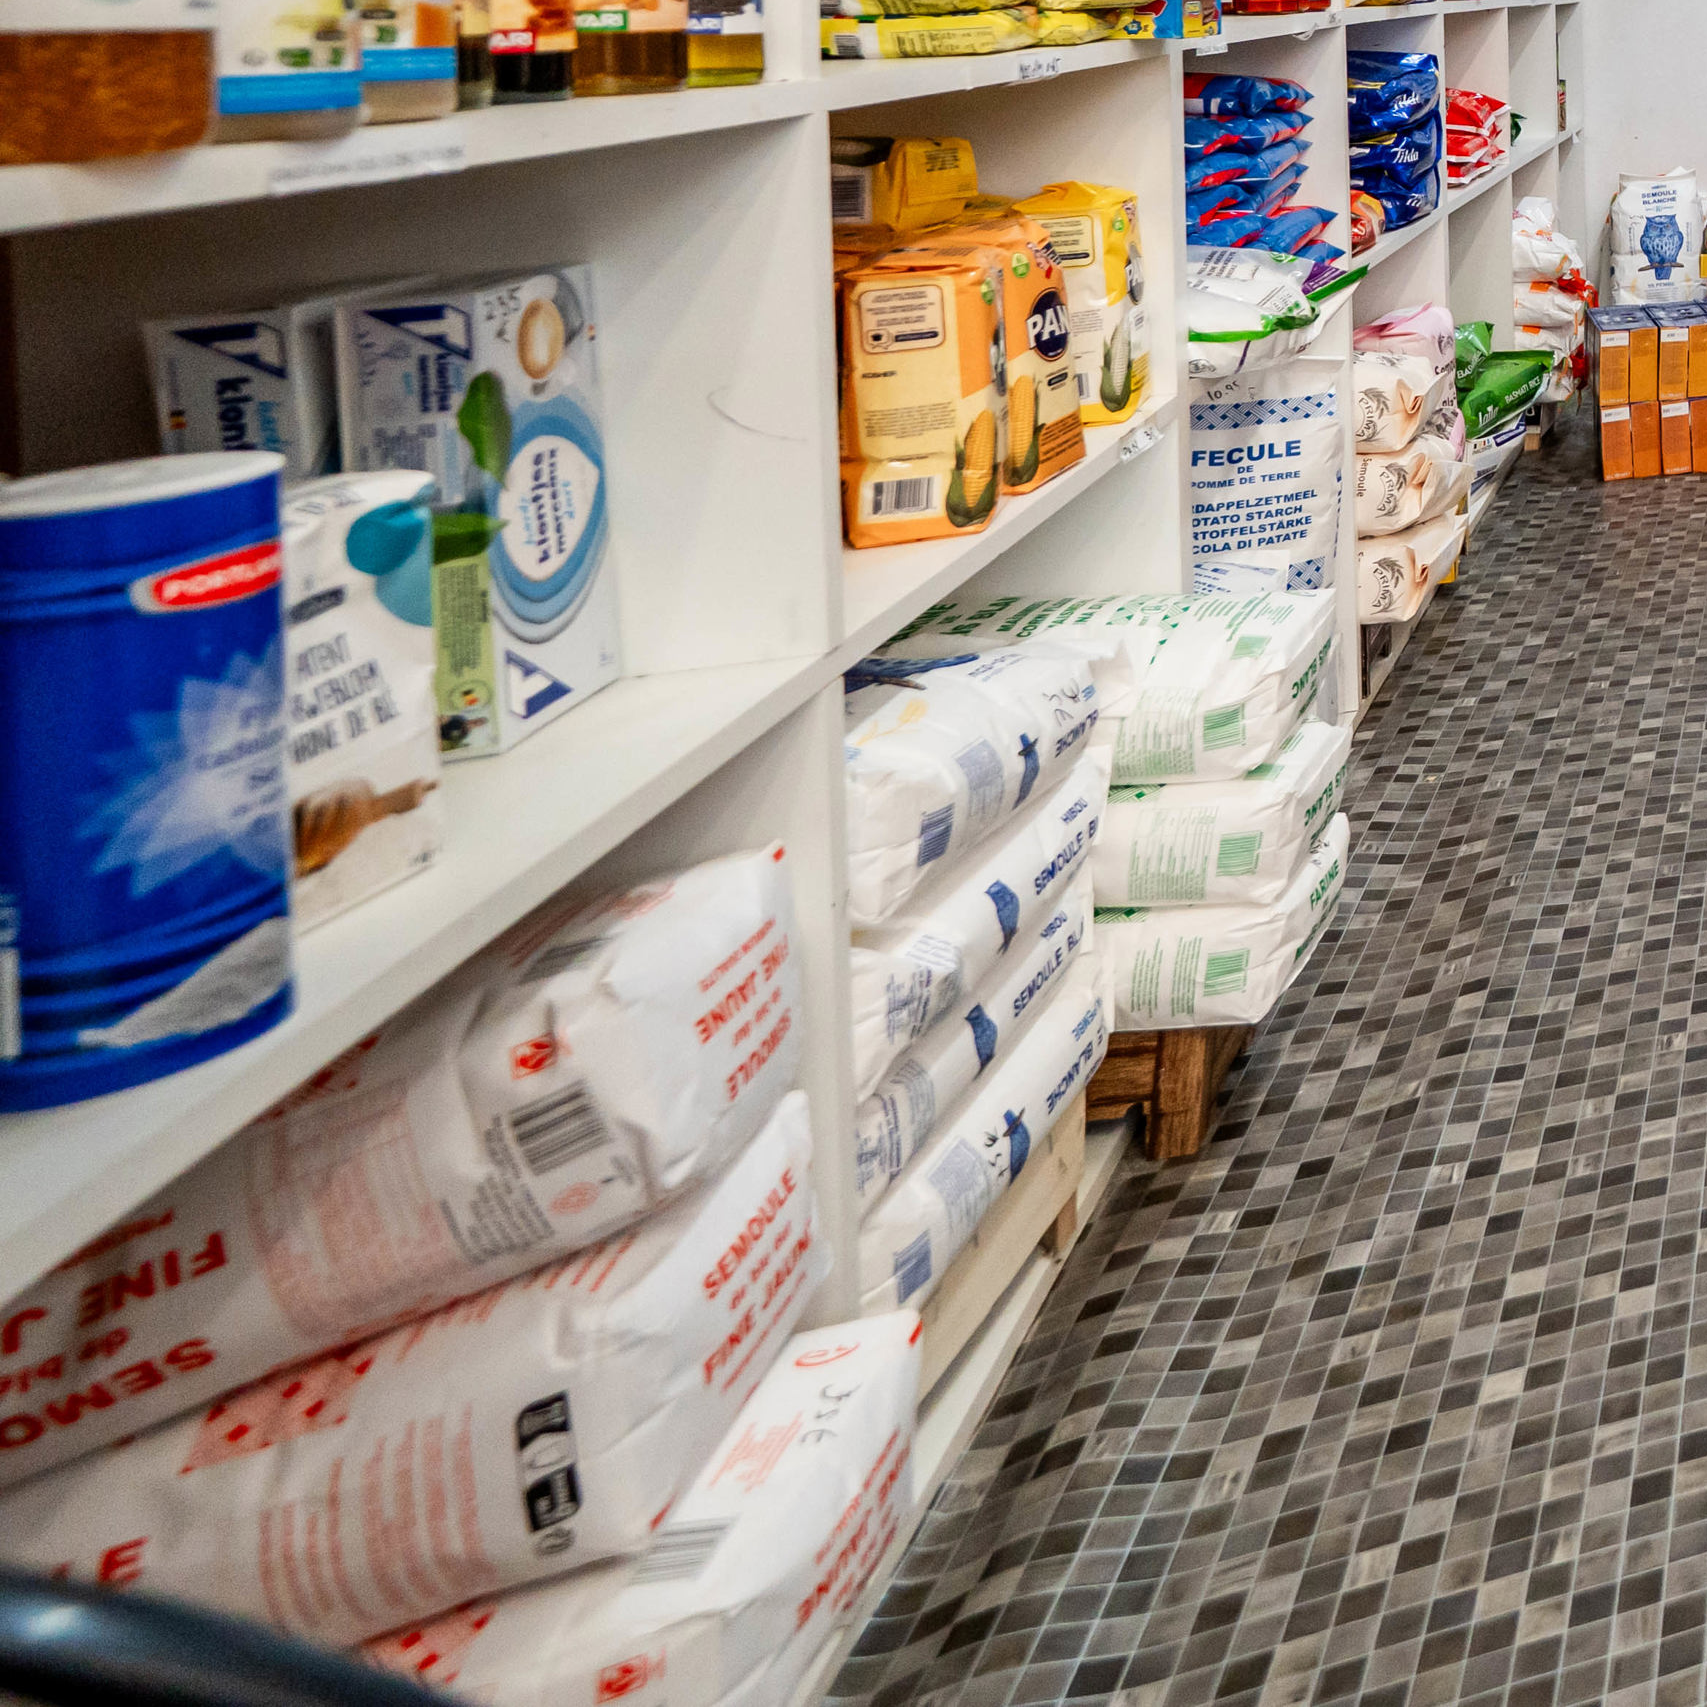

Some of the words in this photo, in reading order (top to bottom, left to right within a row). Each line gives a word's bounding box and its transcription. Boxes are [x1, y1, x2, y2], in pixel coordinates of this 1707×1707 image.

[1393, 146, 1419, 164] Tilda
[1641, 189, 1677, 198] SEMOULE
[1643, 196, 1677, 204] BLANCHE
[1026, 304, 1069, 350] PAN
[1504, 383, 1530, 404] BASMATI
[1355, 397, 1375, 440] PRIMA
[1191, 440, 1302, 467] FECULE
[1237, 465, 1254, 474] DE
[1240, 475, 1256, 485] DE
[1259, 471, 1301, 483] TERRE
[1355, 457, 1372, 498] Semoule
[1375, 471, 1395, 511] PRIMA
[1192, 512, 1243, 528] OTATO
[1246, 505, 1303, 522] STARCH
[1237, 540, 1251, 550] DI
[1258, 529, 1308, 547] PATATE
[1308, 858, 1340, 909] FARINE
[1013, 952, 1064, 1018] SEMOULE
[703, 1167, 798, 1300] SEMOULE
[77, 1232, 229, 1328] FINE
